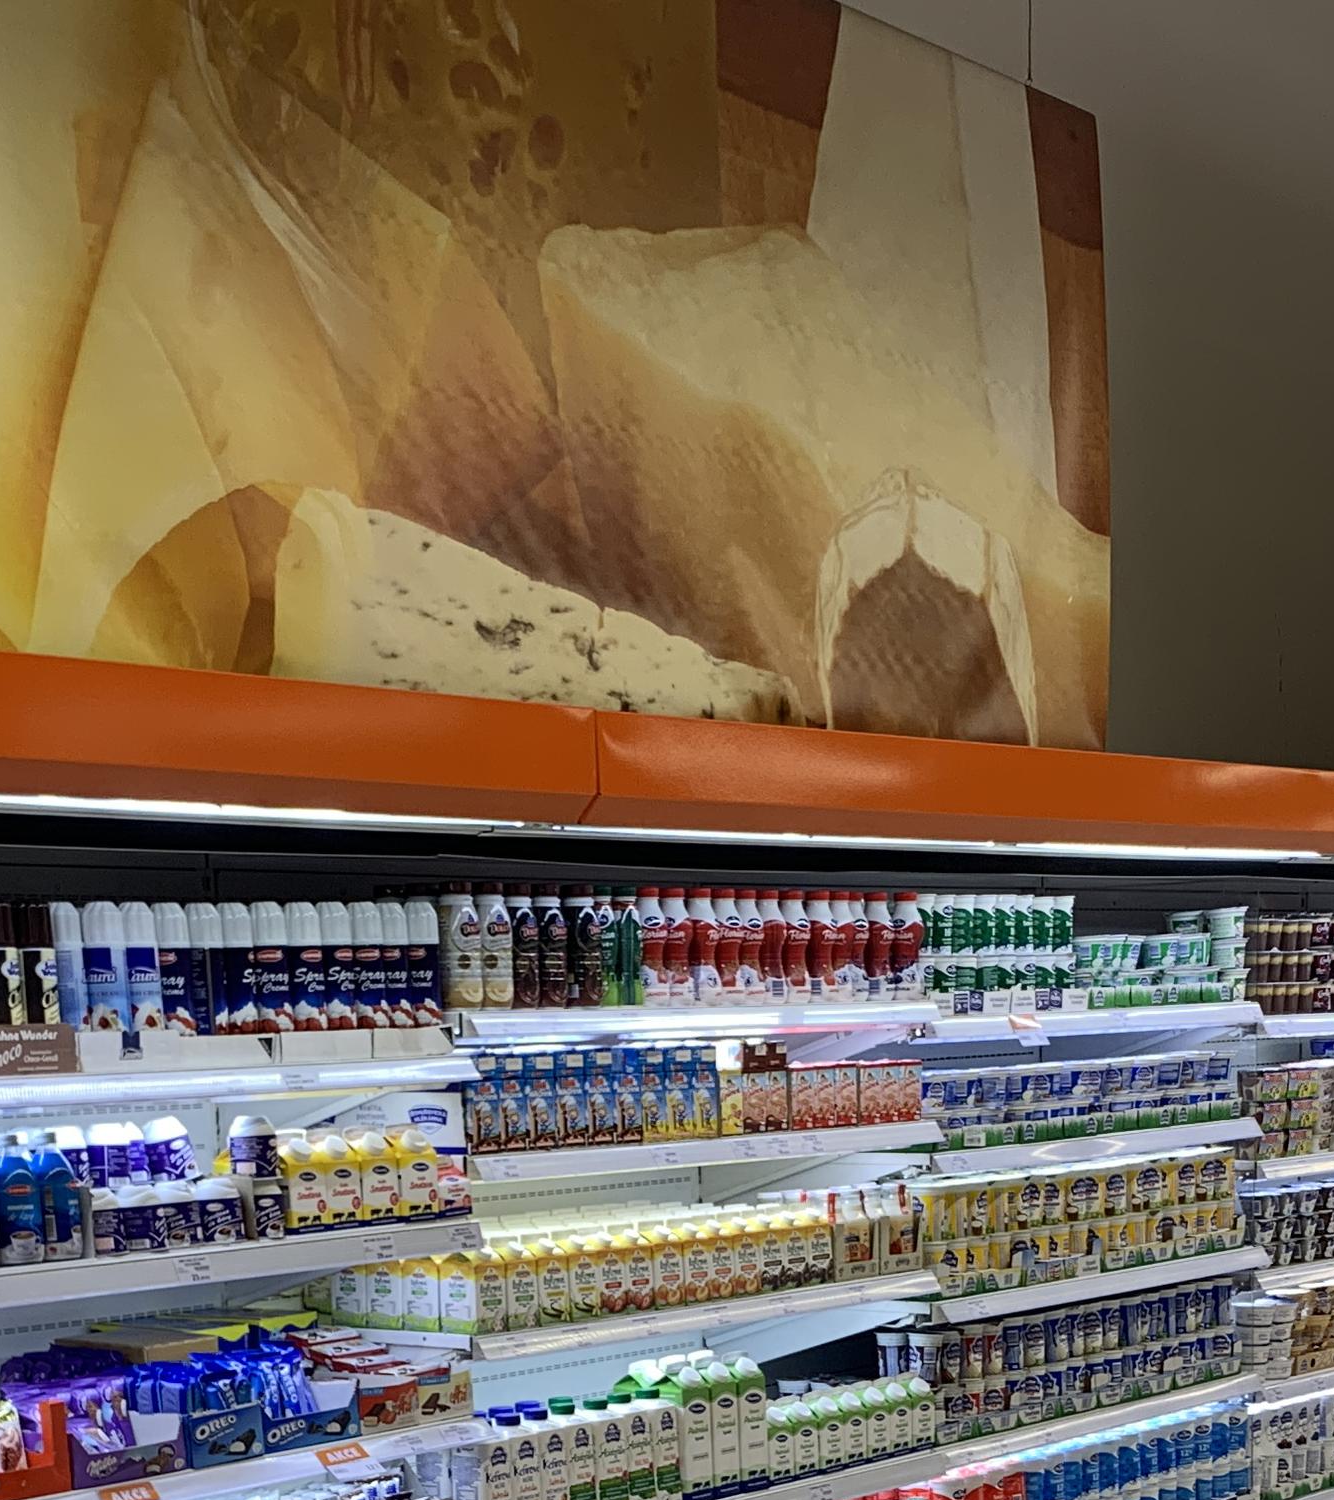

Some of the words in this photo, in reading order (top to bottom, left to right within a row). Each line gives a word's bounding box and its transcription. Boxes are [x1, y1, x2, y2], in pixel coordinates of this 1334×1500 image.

[20, 1029, 58, 1041] Wunder
[194, 1414, 237, 1441] OREO
[267, 1418, 307, 1445] OREO
[325, 1447, 361, 1463] AKCE
